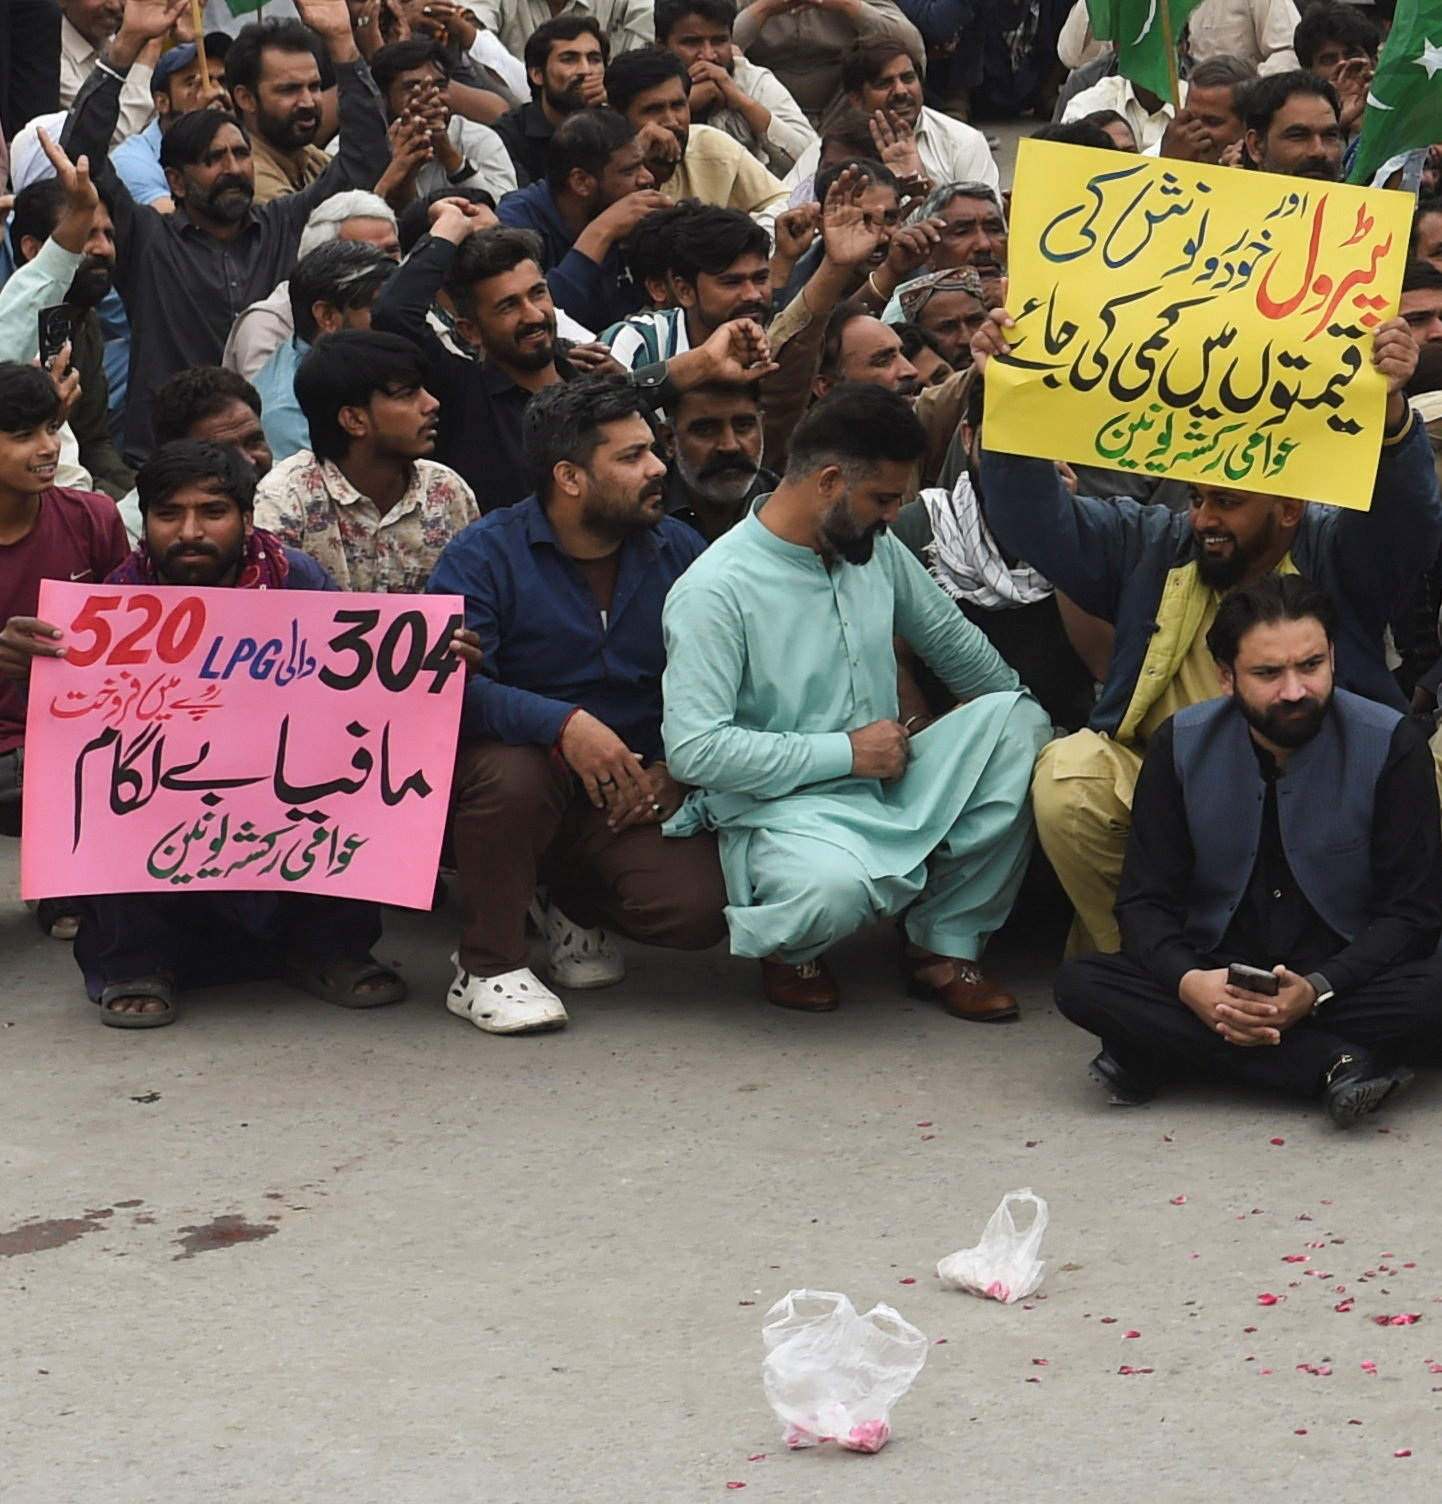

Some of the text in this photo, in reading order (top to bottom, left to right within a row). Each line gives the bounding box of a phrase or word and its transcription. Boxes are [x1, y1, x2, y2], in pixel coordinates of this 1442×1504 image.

[1040, 163, 1151, 263] کی
[1264, 192, 1310, 220] اور
[1069, 286, 1164, 393] کی
[1109, 295, 1220, 403] کمی
[1158, 322, 1238, 420] میں
[1219, 322, 1366, 436] قیمتوں
[1094, 403, 1303, 482] عوامی رکشہ یونین
[63, 594, 207, 667] 520
[198, 636, 282, 681] LPG
[49, 671, 143, 727] فروخت
[139, 672, 182, 721] میں
[273, 713, 433, 824] مافیا
[147, 811, 369, 886] عوامی رکشہ یونین
